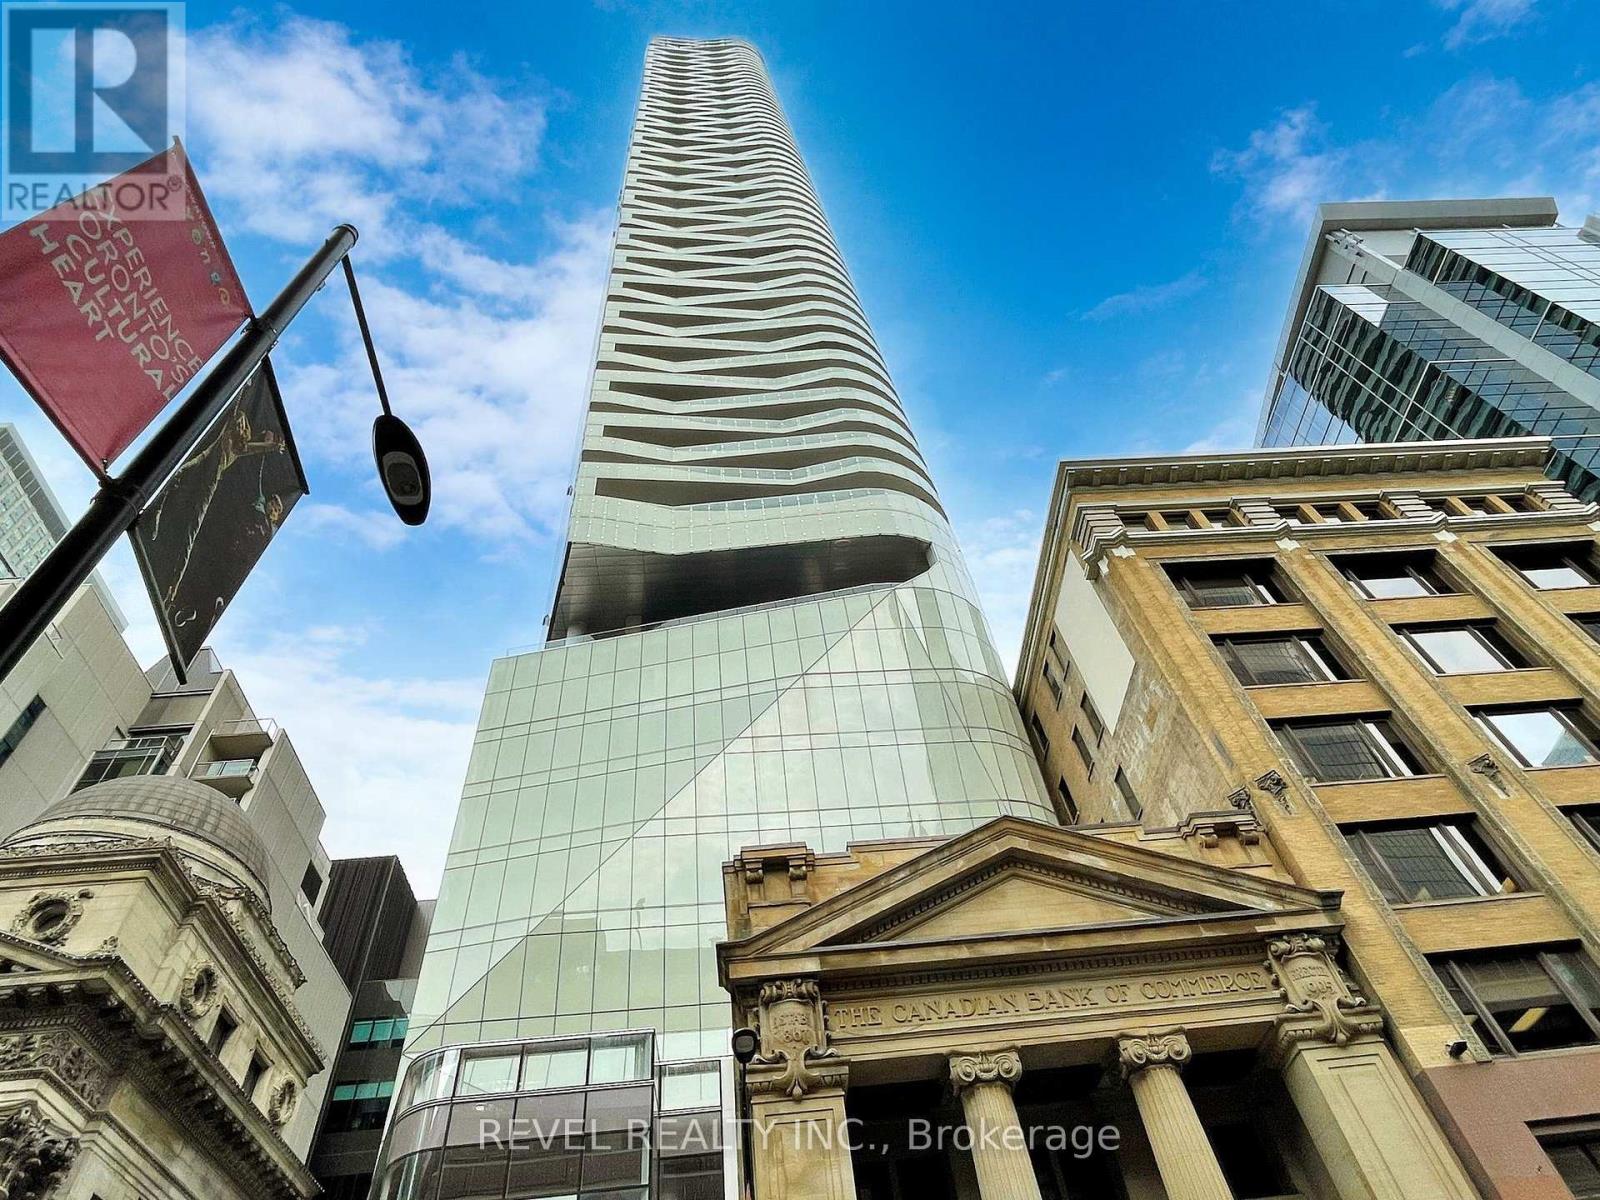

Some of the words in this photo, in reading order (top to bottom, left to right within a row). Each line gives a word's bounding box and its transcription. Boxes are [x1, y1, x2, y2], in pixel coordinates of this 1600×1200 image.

[29, 223, 115, 341] HEART
[66, 234, 176, 400] CULTURAL
[94, 186, 202, 375] EXPERIENCE
[834, 1005, 883, 1028] THE
[893, 993, 1020, 1023] CANADIAN
[1028, 987, 1098, 1012] BANK
[1105, 983, 1130, 1003] OF
[1141, 971, 1267, 1000] COMMERCE
